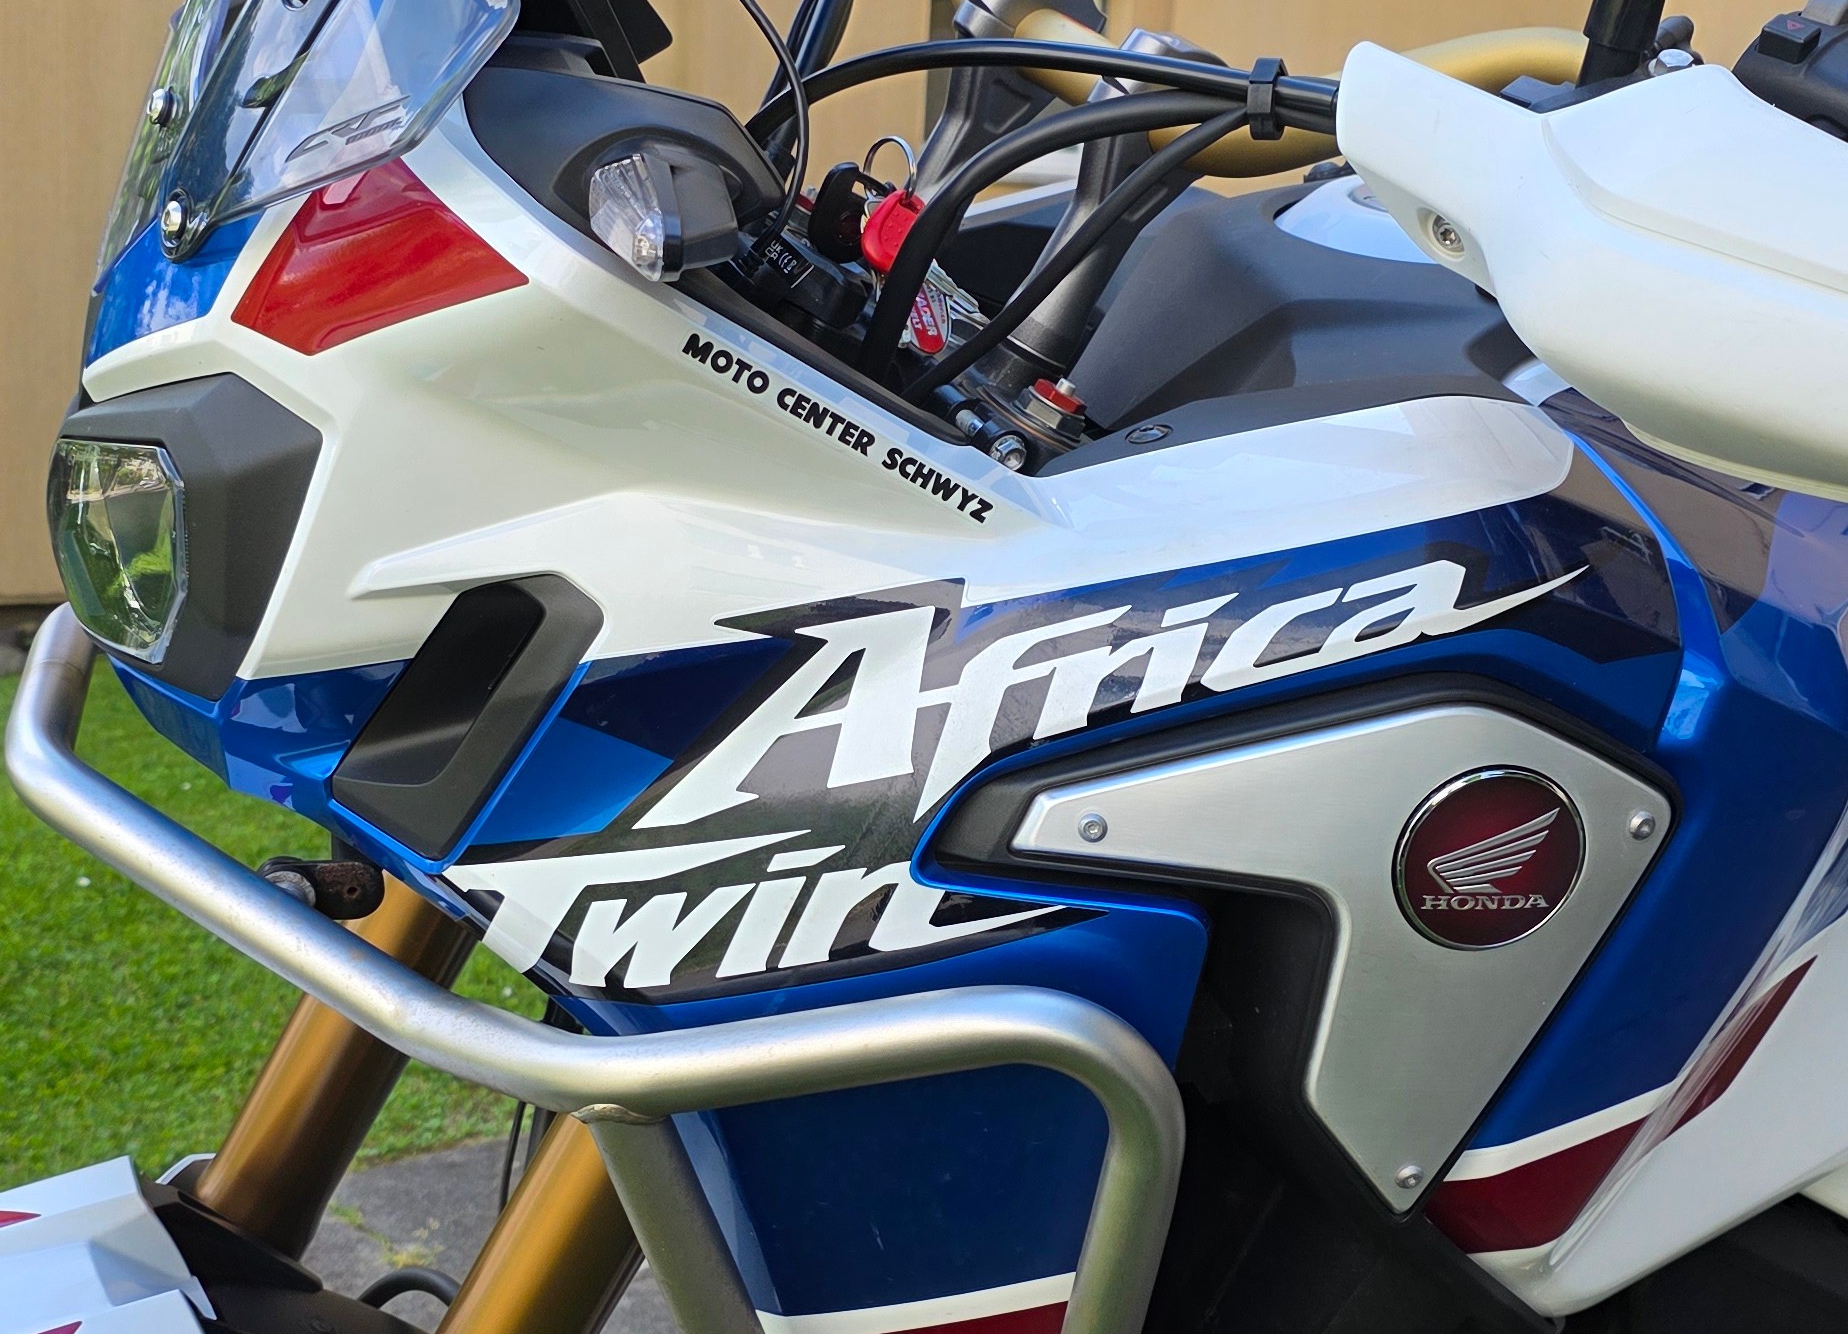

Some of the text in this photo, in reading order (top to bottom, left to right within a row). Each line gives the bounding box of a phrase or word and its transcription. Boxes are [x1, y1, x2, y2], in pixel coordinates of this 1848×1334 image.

[682, 333, 994, 524] MOTO CENTER SCHWYZ
[632, 559, 1590, 828] Africa
[442, 829, 1094, 989] Twin
[1421, 893, 1550, 910] HONDA
